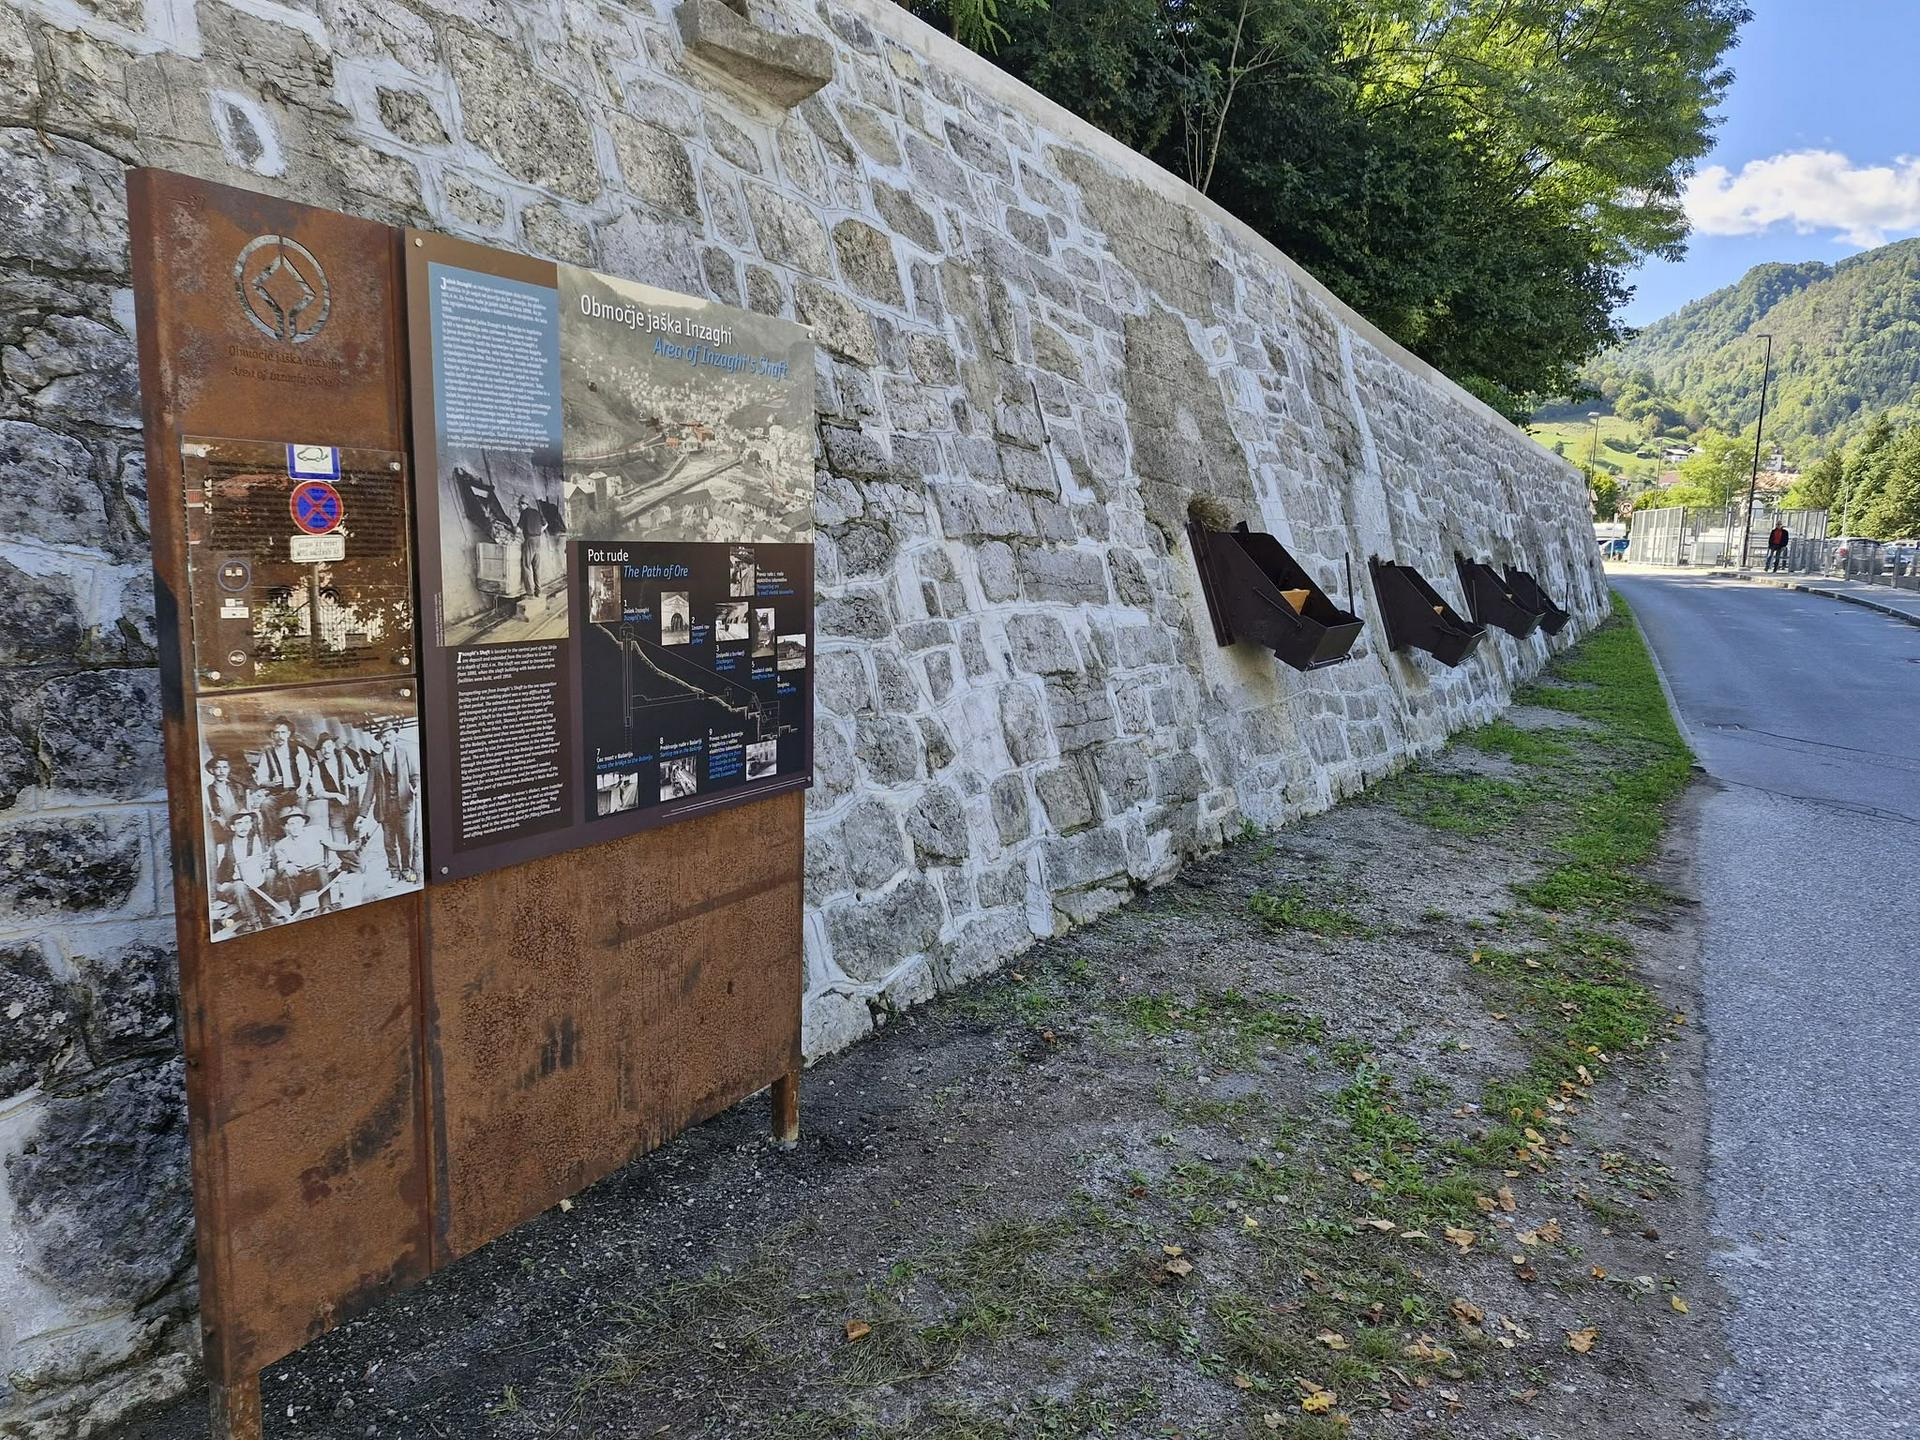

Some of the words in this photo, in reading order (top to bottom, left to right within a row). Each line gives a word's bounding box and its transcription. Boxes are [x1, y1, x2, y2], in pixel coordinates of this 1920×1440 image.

[580, 294, 644, 330] Območje
[646, 309, 682, 336] jaška
[685, 318, 733, 346] Inzaghi
[653, 337, 682, 358] Area
[686, 344, 701, 366] of
[702, 346, 757, 373] Inzaghi's
[759, 354, 790, 382] Shaft
[588, 549, 604, 562] Pot
[607, 549, 628, 562] rude
[624, 566, 640, 577] The
[642, 565, 661, 577] Path
[664, 565, 674, 580] of
[674, 564, 688, 577] Ore
[709, 728, 712, 736] 9
